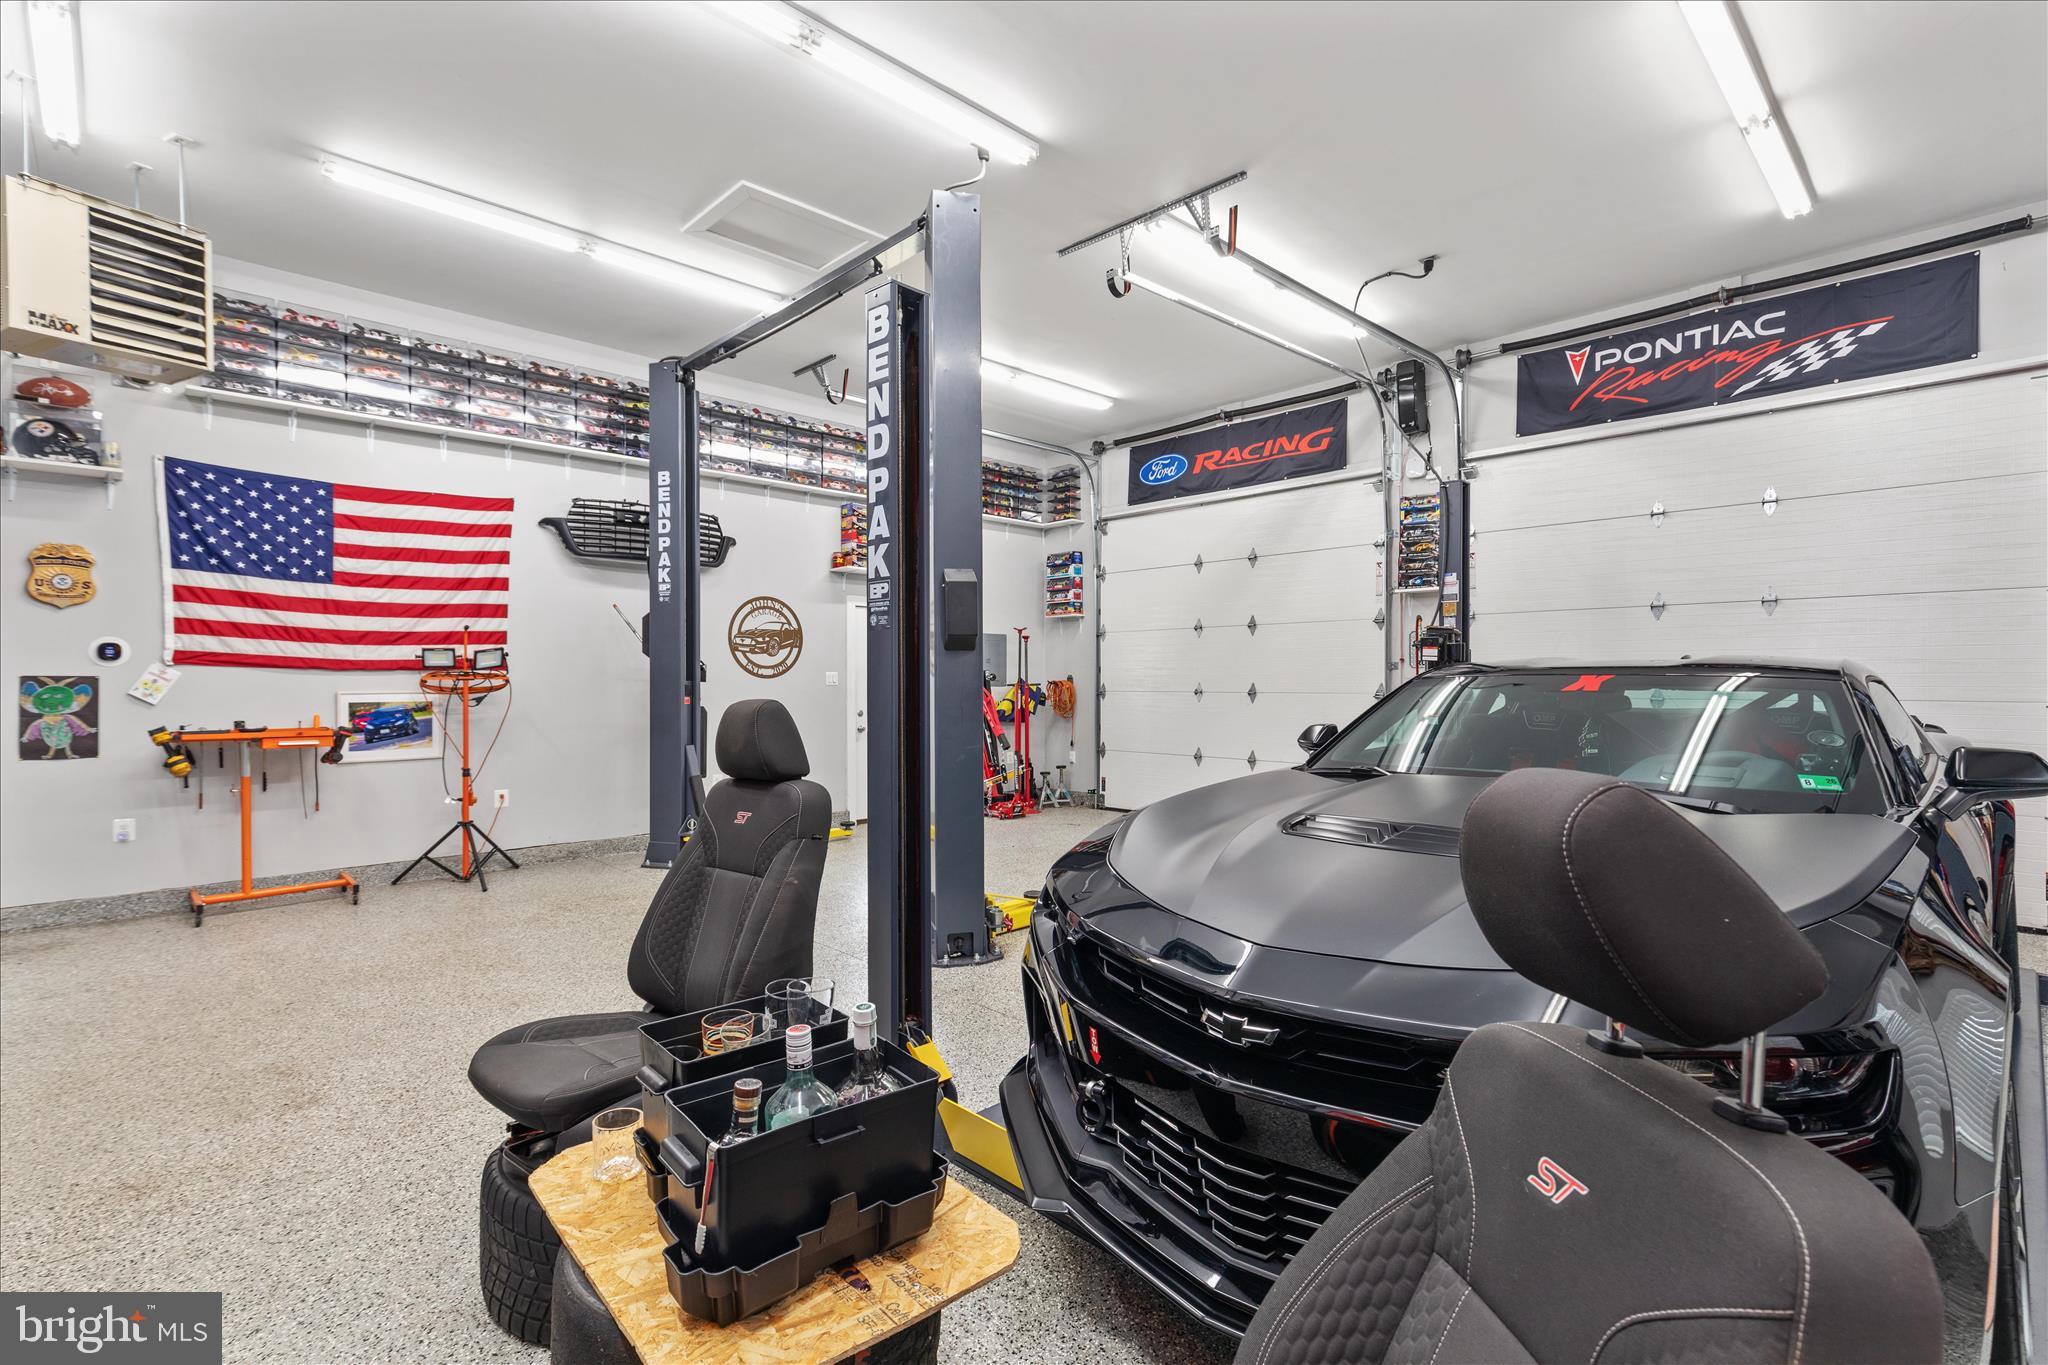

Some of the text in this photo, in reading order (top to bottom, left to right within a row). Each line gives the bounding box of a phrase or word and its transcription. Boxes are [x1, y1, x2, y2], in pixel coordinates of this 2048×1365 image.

[1595, 310, 1786, 371] PONTIAC
[1569, 334, 1812, 411] Racing
[868, 303, 890, 579] BENDPAK
[1148, 426, 1335, 480] Ford RACING
[657, 471, 671, 582] BENDPAK
[733, 811, 753, 824] ST
[1527, 1156, 1590, 1204] ST
